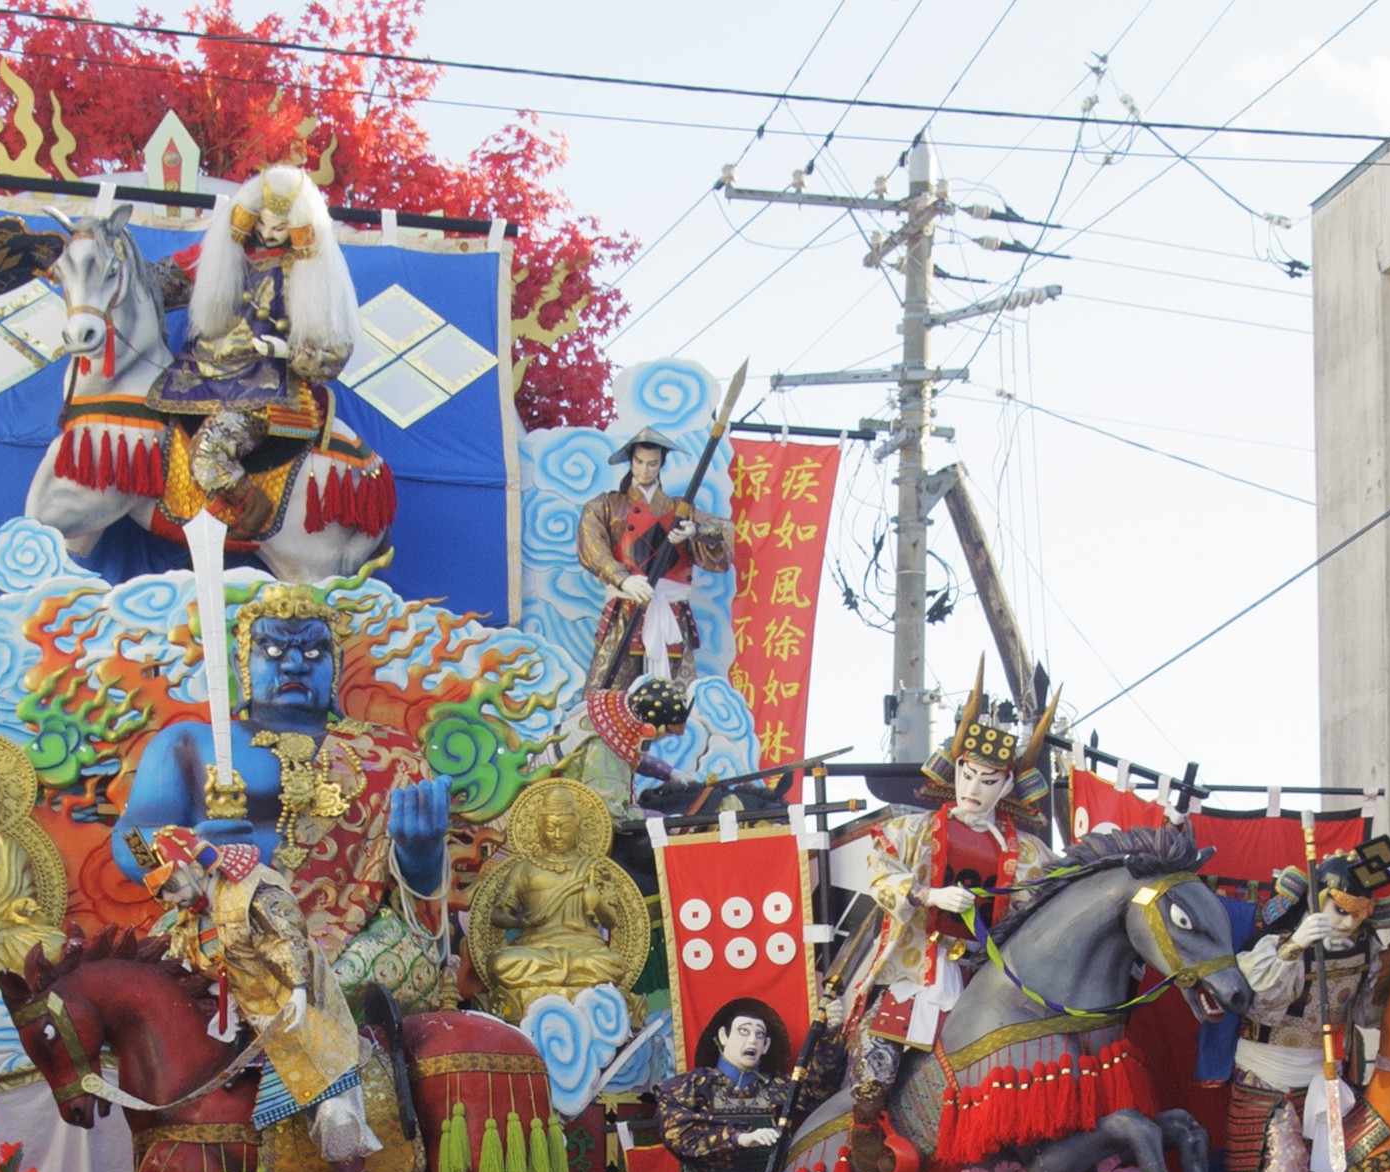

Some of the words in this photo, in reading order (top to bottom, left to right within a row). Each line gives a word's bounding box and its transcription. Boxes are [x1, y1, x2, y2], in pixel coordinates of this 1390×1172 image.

[759, 457, 823, 790] 疾如風徐如林
